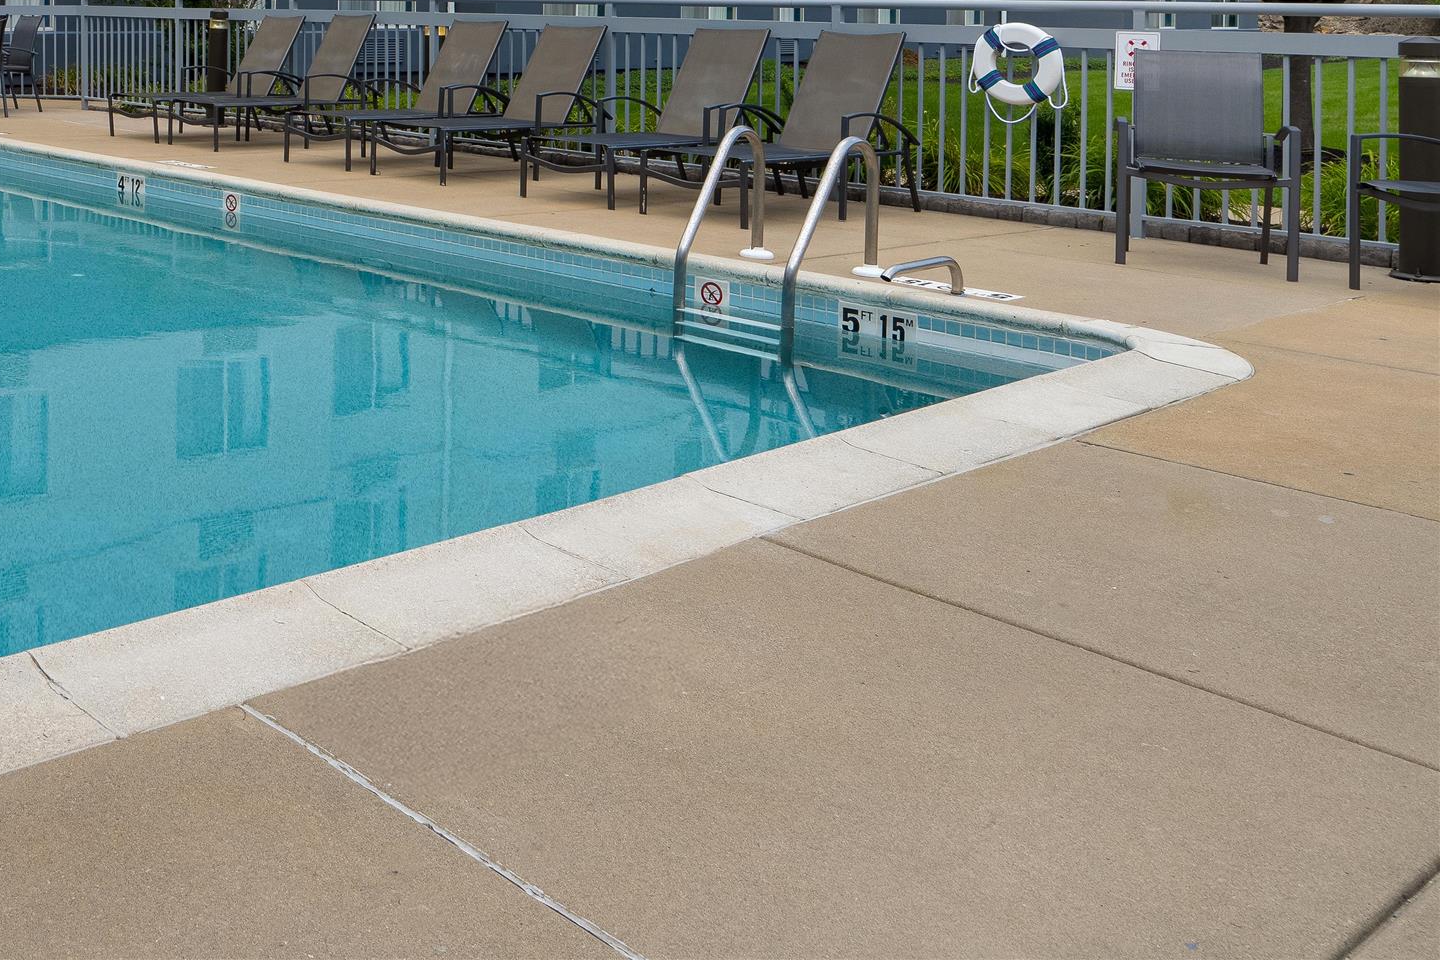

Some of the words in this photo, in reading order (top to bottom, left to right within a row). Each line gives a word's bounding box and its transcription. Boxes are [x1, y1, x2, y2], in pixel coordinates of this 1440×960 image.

[118, 175, 125, 191] 4
[842, 307, 860, 333] 5
[861, 310, 873, 321] FT
[880, 314, 905, 342] 15
[905, 319, 914, 328] M
